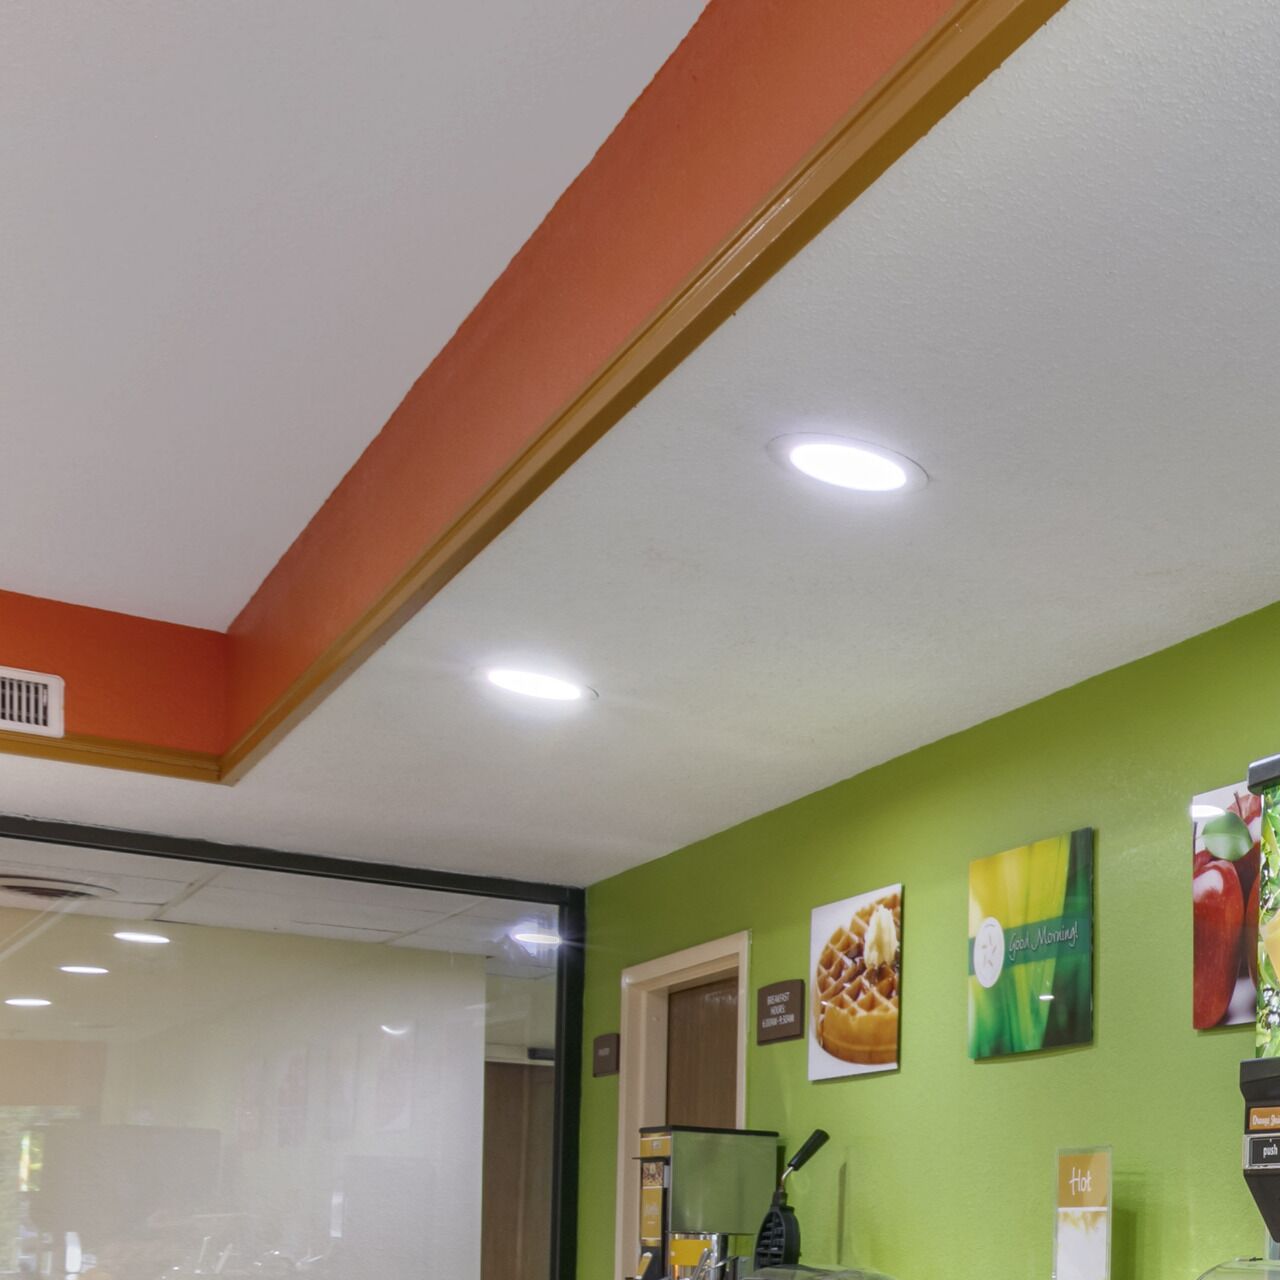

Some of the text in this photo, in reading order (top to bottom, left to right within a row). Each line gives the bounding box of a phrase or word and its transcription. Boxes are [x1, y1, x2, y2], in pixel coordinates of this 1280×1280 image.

[1008, 920, 1078, 961] Good Morning!
[1263, 1144, 1278, 1158] push
[1069, 1167, 1092, 1196] Hot
